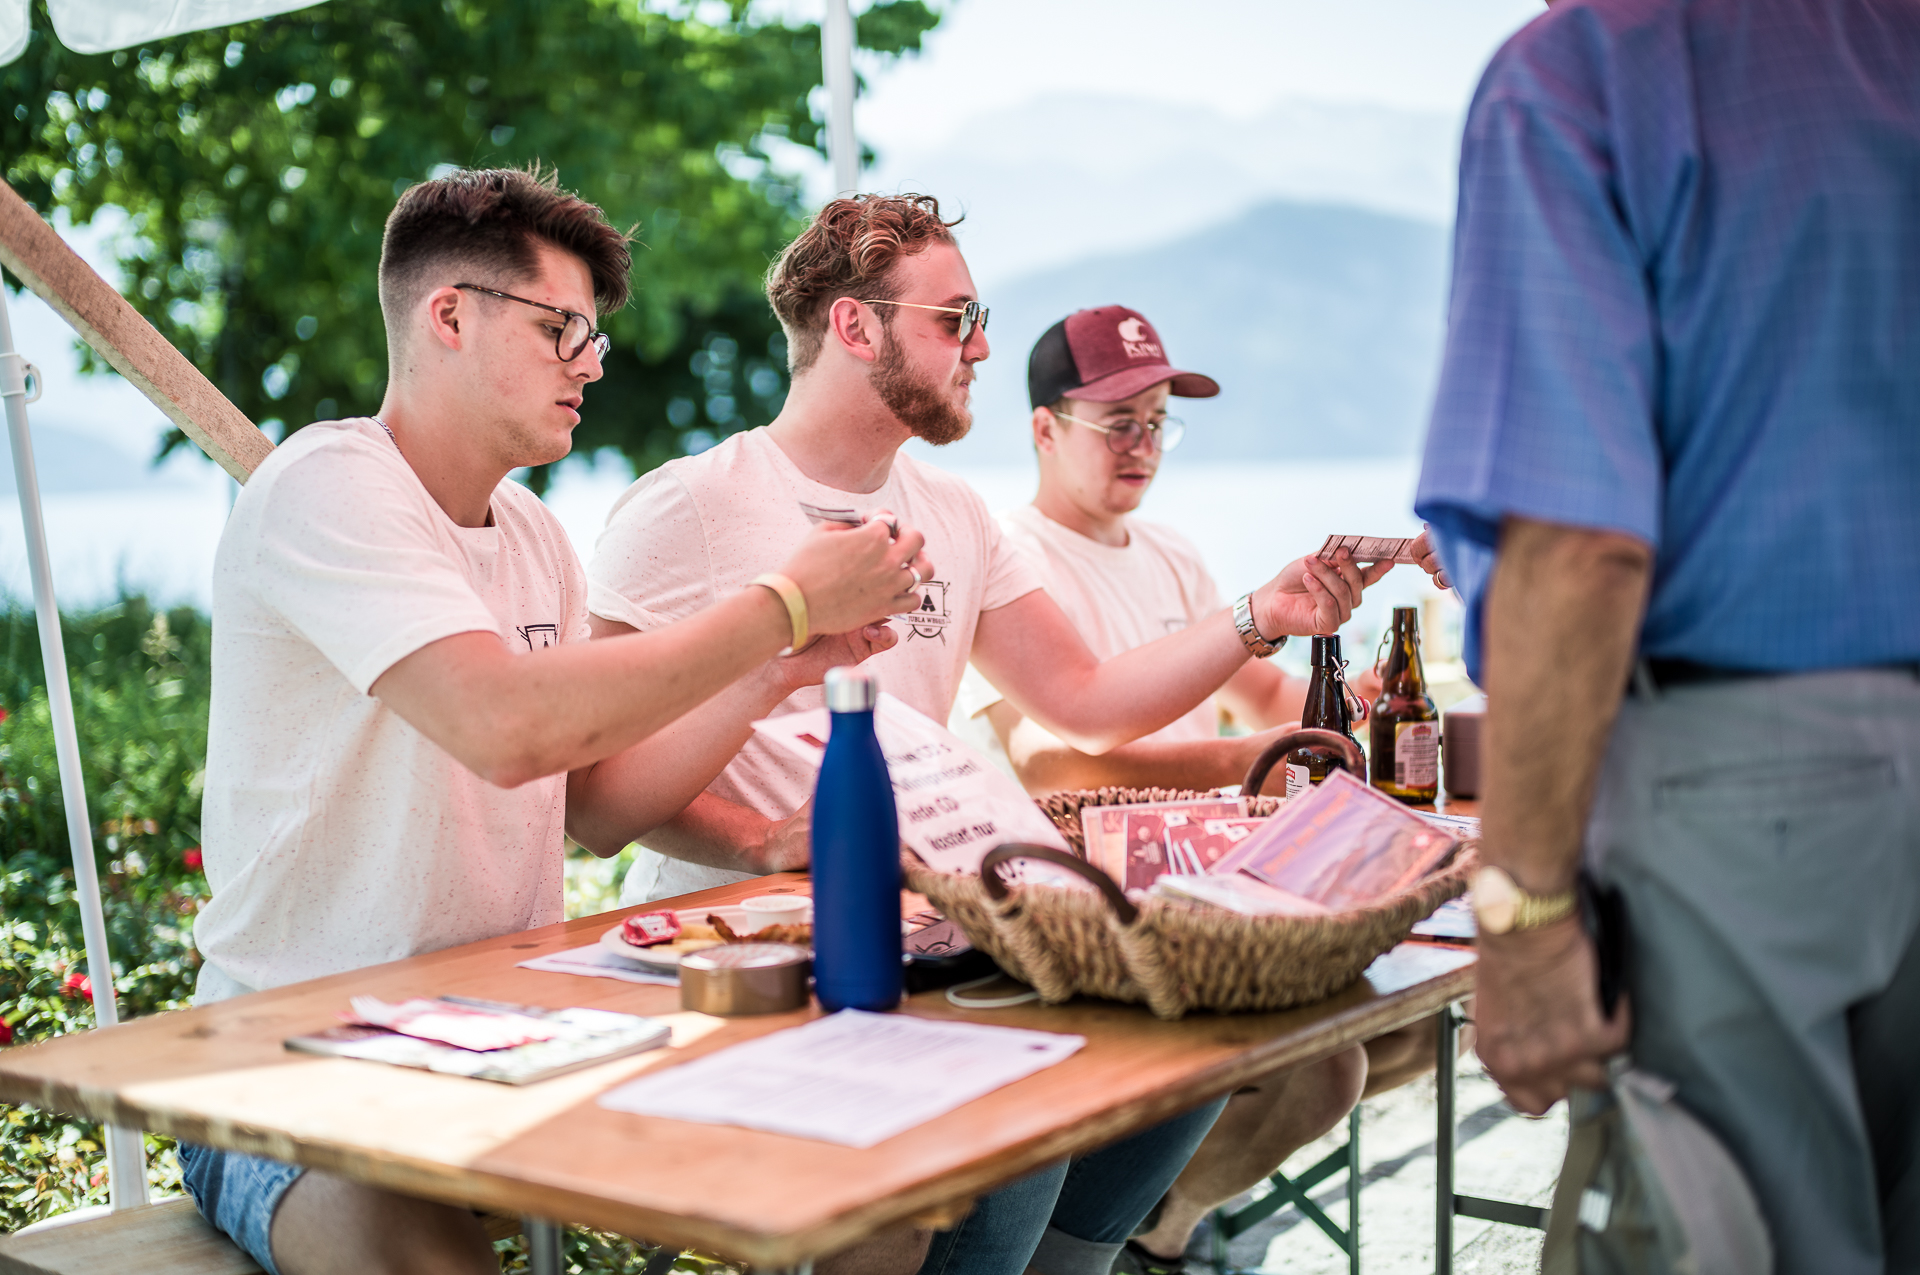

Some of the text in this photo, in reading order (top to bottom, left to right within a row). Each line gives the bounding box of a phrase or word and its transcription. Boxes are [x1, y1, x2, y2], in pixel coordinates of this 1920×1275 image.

[908, 615, 926, 623] JUBLA
[934, 796, 960, 813] CD
[924, 821, 998, 853] kostet nur
